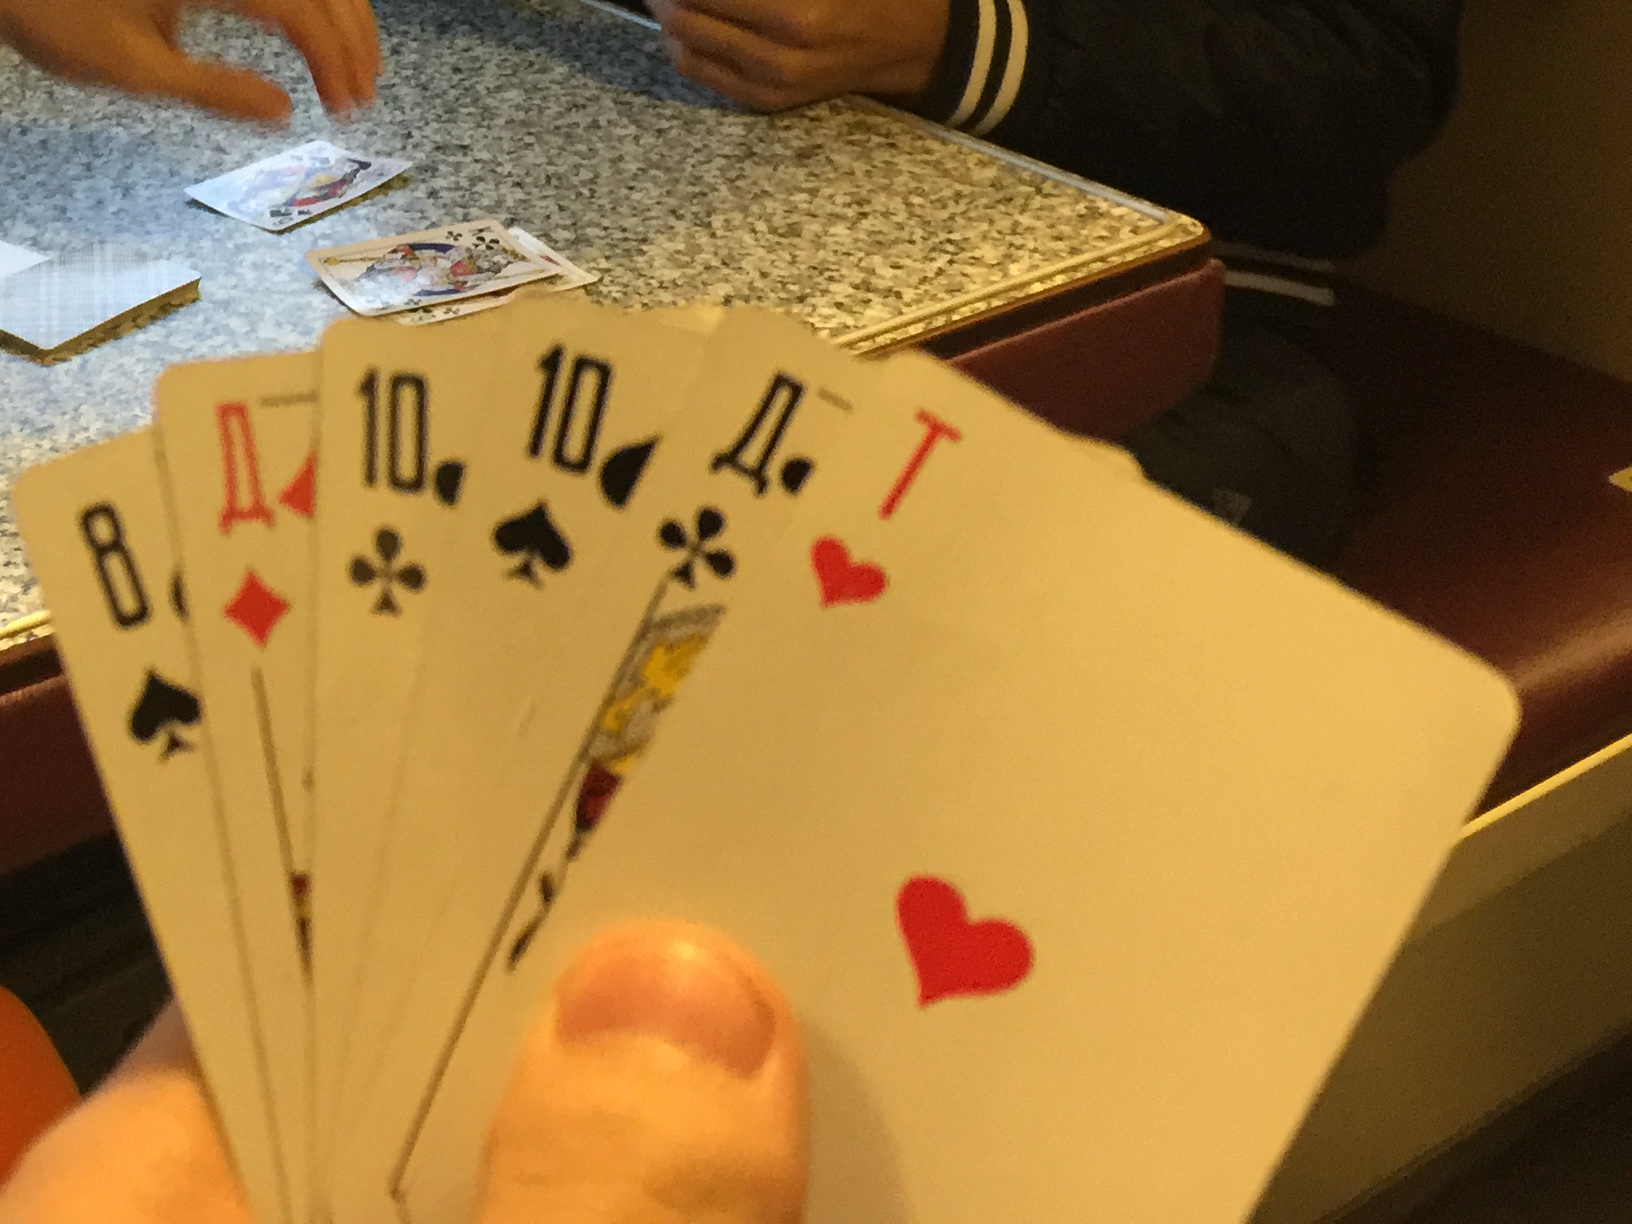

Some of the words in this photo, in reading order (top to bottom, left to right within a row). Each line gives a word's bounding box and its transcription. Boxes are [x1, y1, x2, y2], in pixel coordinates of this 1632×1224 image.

[216, 401, 275, 536] Д
[357, 364, 430, 494] 10
[527, 340, 614, 475] 10
[709, 371, 807, 498] Д
[77, 500, 152, 630] 8
